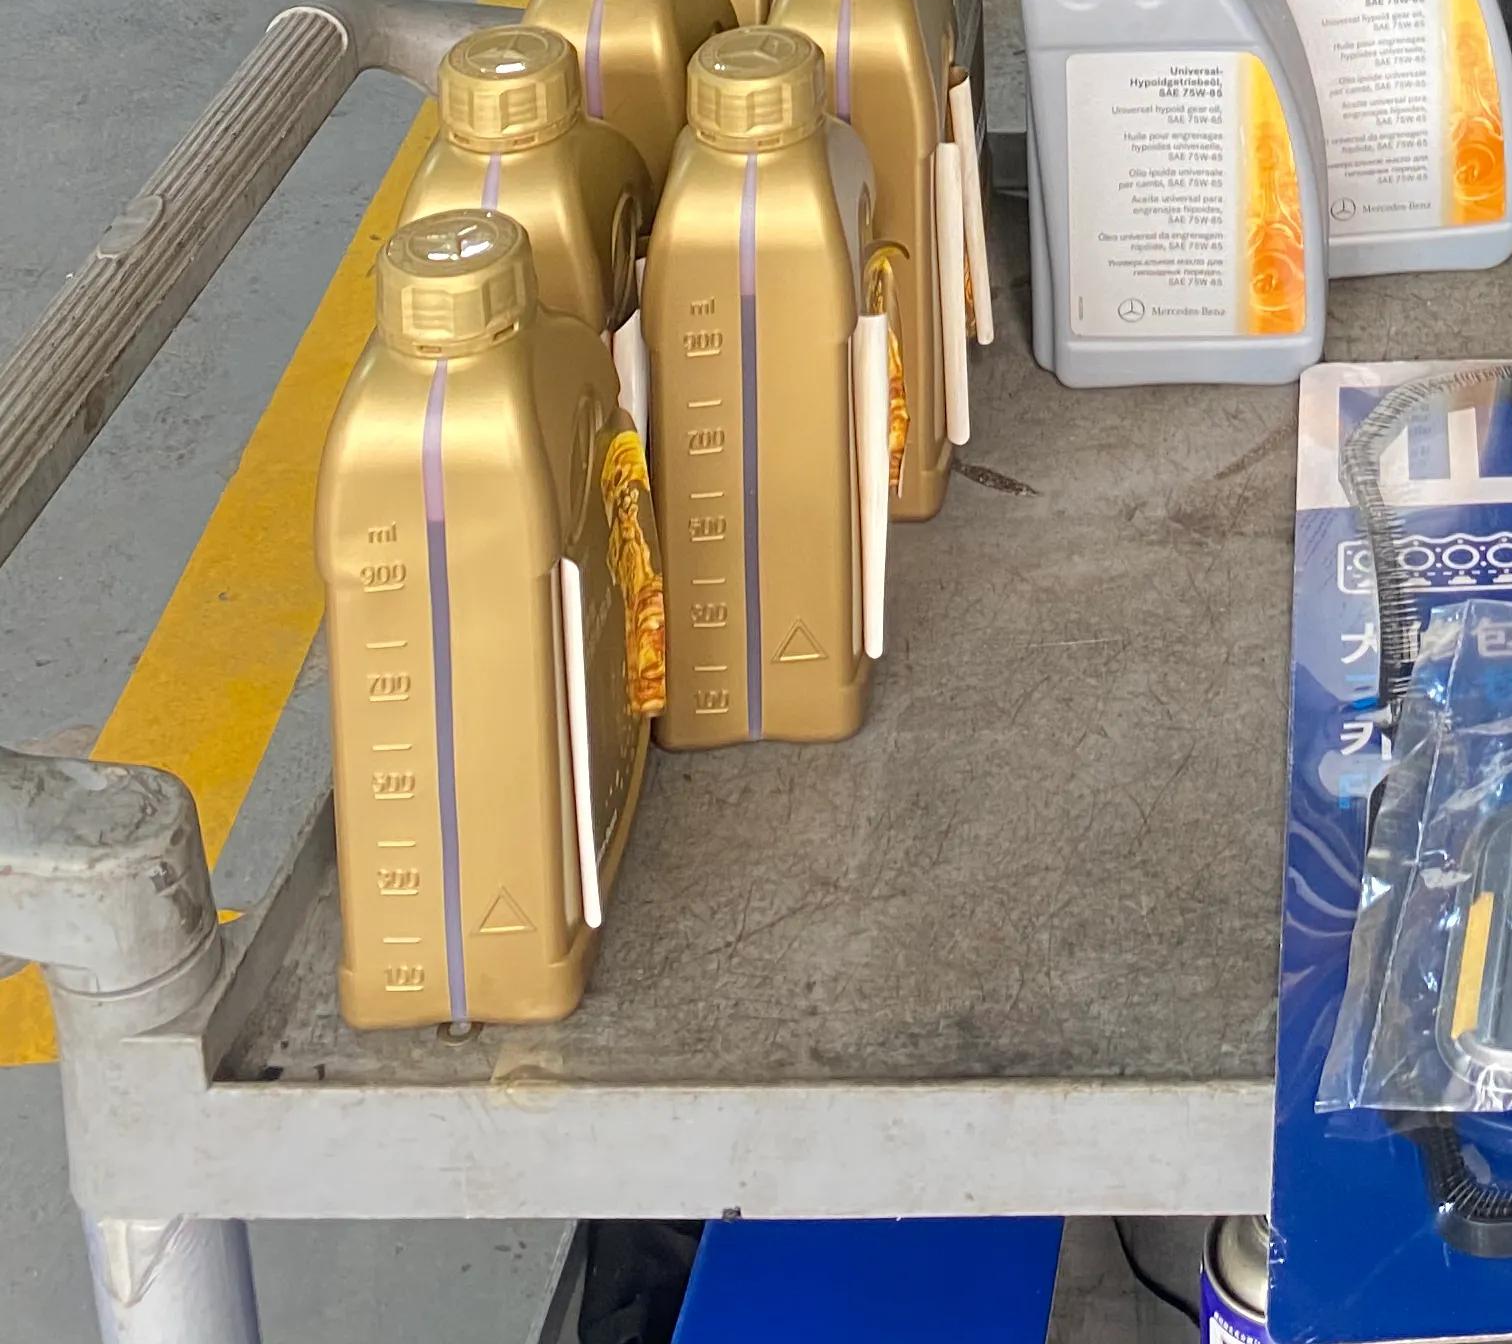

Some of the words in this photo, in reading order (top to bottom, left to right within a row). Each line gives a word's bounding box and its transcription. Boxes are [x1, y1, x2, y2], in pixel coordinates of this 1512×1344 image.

[1170, 66, 1223, 76] Universal-
[1159, 88, 1179, 98] SAE
[1167, 115, 1185, 125] SAE
[1151, 305, 1227, 317] Mercedes-Benz
[687, 428, 726, 450] 700
[367, 520, 398, 544] ml
[359, 560, 408, 586] 900
[366, 672, 412, 696] 700
[383, 964, 426, 986] 100
